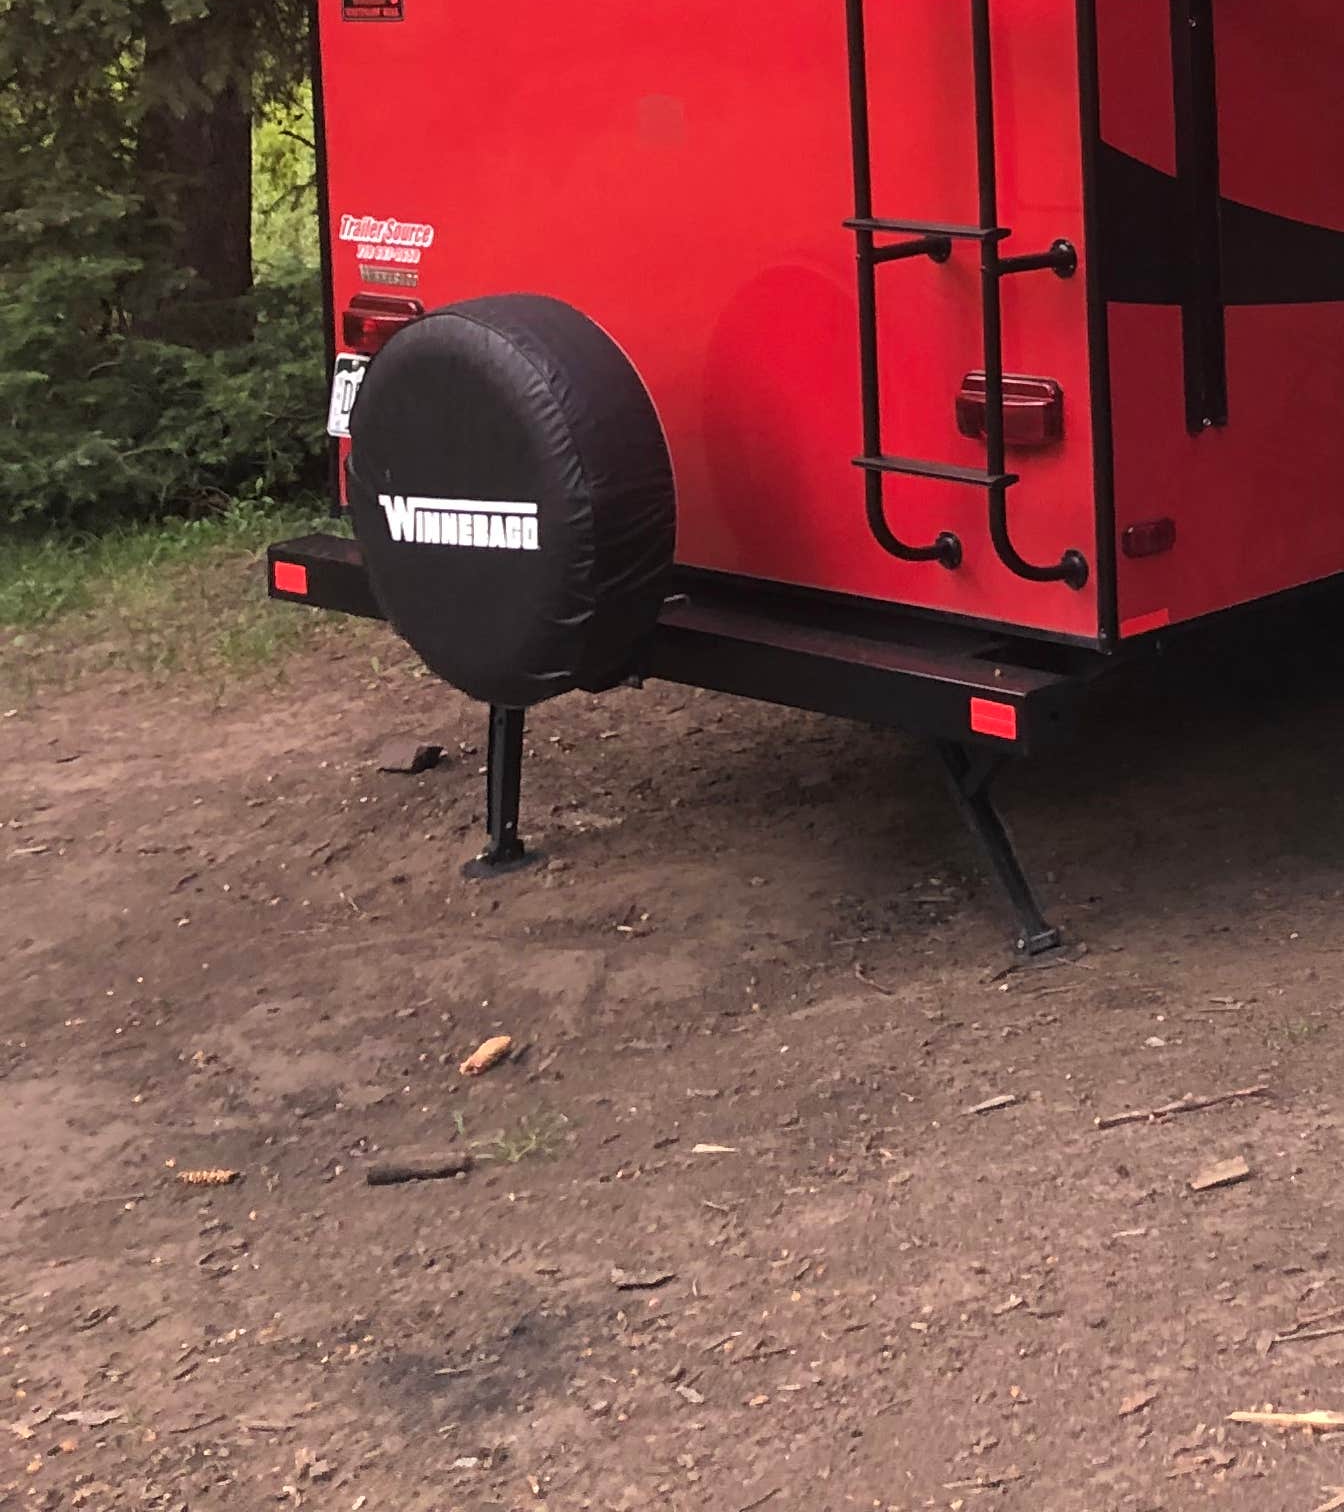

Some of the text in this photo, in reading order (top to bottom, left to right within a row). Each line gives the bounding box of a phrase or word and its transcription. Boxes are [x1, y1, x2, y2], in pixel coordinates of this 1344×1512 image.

[339, 214, 434, 248] Trailer Source
[378, 494, 540, 550] WINNEBAGO
